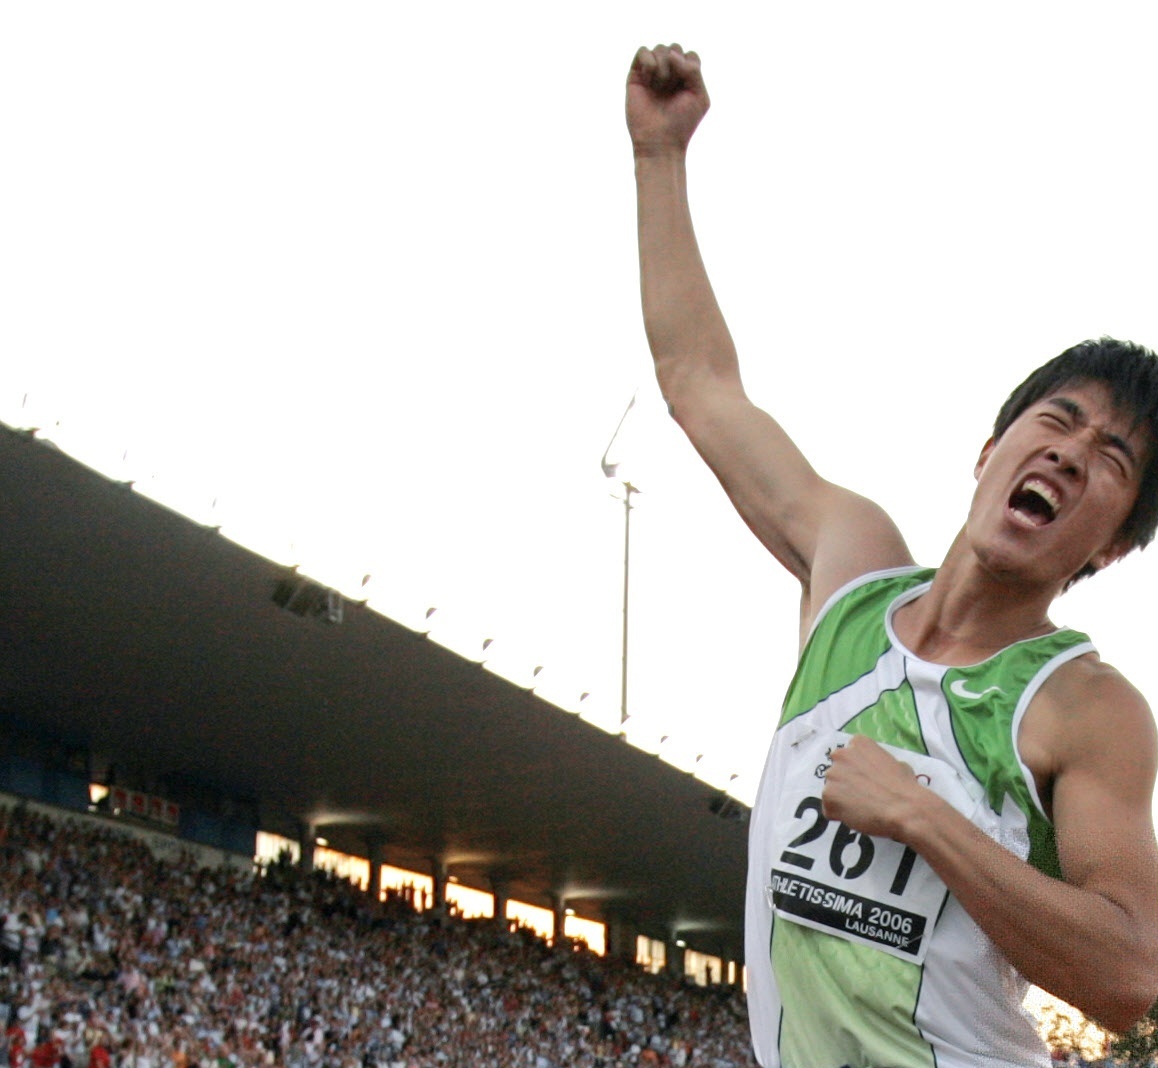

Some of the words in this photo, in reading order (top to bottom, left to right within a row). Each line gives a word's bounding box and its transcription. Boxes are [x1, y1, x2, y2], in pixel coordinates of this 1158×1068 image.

[780, 796, 917, 896] 261
[845, 918, 910, 948] LAUSANNE
[868, 907, 913, 934] 2006
